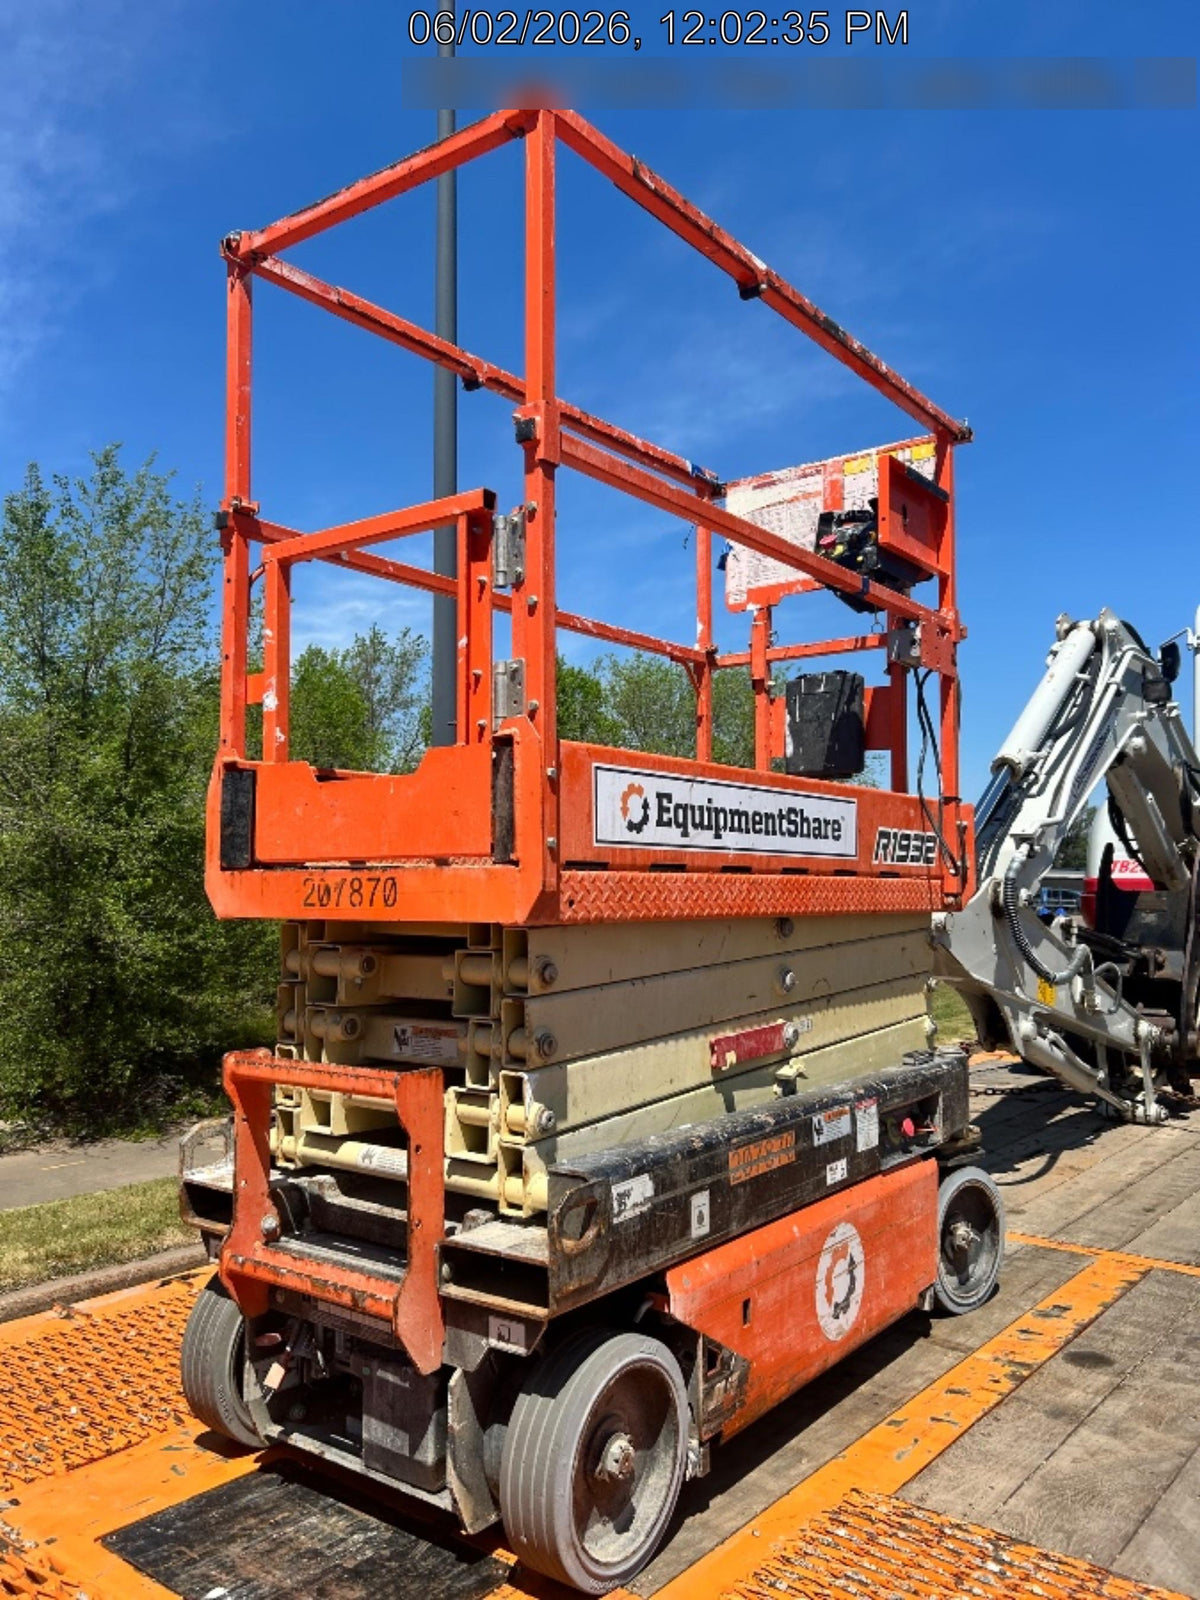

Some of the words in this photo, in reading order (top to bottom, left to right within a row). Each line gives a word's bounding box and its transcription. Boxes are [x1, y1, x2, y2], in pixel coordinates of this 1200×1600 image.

[656, 792, 842, 842] EquipmentShare
[874, 827, 938, 865] R1932
[1110, 860, 1145, 874] TB2
